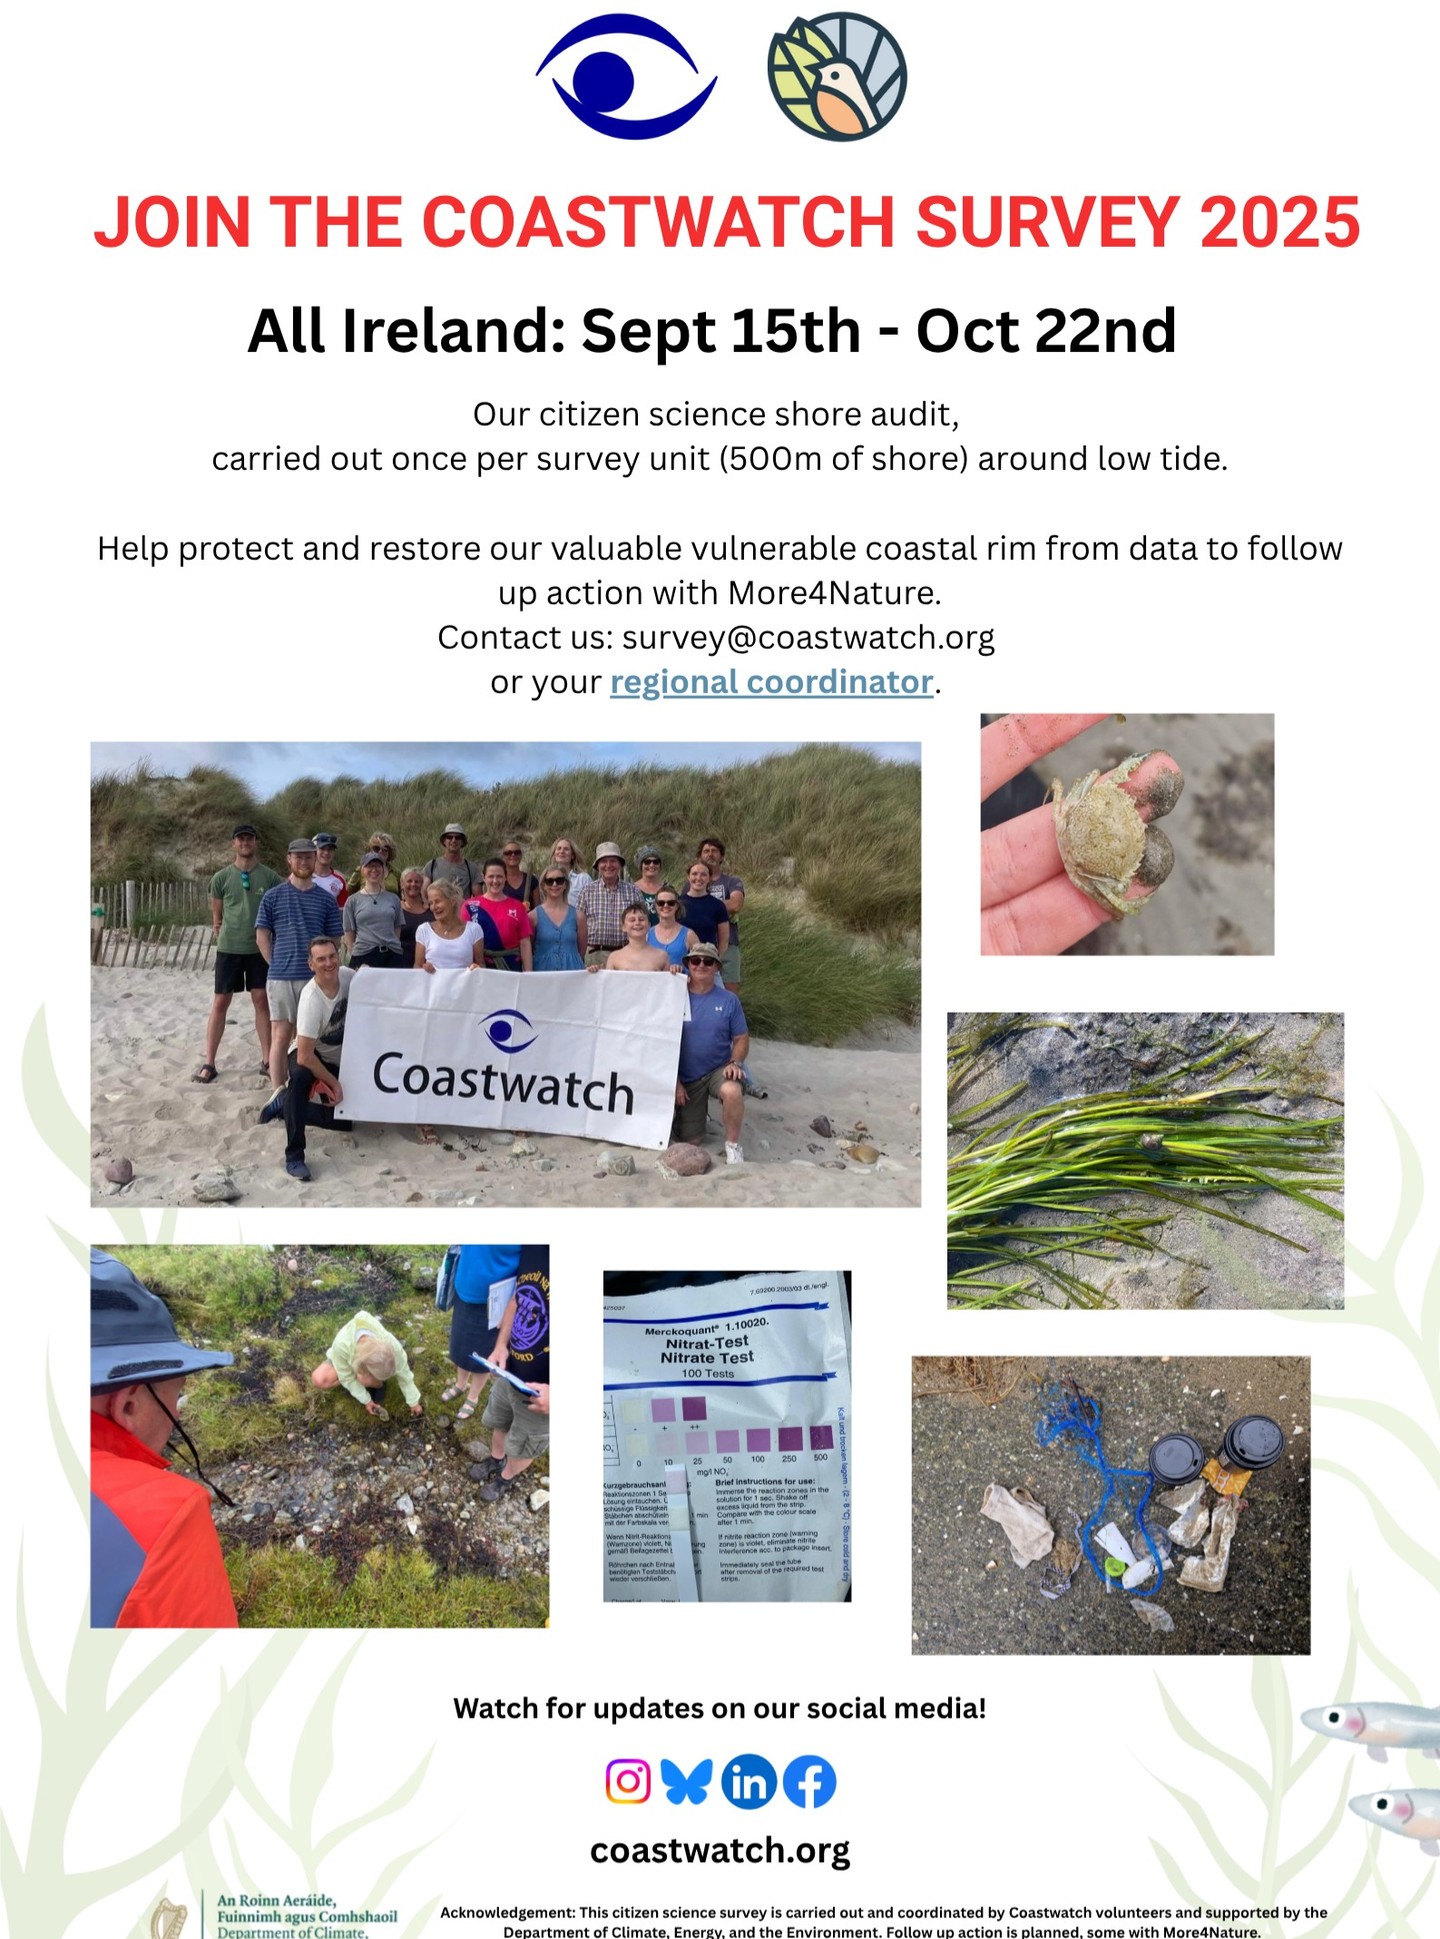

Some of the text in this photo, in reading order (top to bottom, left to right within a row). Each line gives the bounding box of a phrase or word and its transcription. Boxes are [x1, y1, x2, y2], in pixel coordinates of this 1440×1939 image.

[93, 195, 1360, 248] JOIN THE COASTWATCH SURVEY 2025
[247, 305, 1175, 366] All Ireland: Sept 15th - Oct 22nd
[473, 400, 959, 432] Our citizen science shore audit,
[212, 444, 1228, 478] carried out once per survey unit (500m of shore) around low tide.
[99, 534, 1343, 568] Help protect and restore our valuable vulnerable coastal rim from data to follow
[499, 579, 941, 612] up action with More4Nature.
[438, 623, 995, 657] Contact us: survey@coastwatch.org
[491, 667, 942, 702] or your regional coordinator.
[373, 1051, 634, 1116] Coastwatch
[725, 1317, 770, 1332] 1.10020.
[665, 1334, 749, 1350] Nitrat-Test
[660, 1350, 755, 1365] Nitrate Test
[682, 1368, 735, 1379] 100 Tests
[838, 1407, 846, 1421] Kalt
[839, 1422, 847, 1436] und
[840, 1436, 848, 1462] trocken
[636, 1453, 828, 1468] 0 10 25 50 100 250 500
[715, 1478, 734, 1487] Brief
[736, 1478, 783, 1486] instructions
[841, 1572, 850, 1582] dry
[453, 1696, 986, 1725] Watch for updates on our social media!
[732, 1764, 767, 1800] in
[590, 1835, 851, 1871] coastwatch.org
[217, 1894, 337, 1908] An Roinn Aeráide,
[218, 1910, 398, 1926] Fuinnimh agus Comhshaoil
[440, 1906, 1328, 1922] Acknowledgement: This citizen science survey is carried out and coordinated by Coastwatch volunteers and supported by the
[218, 1926, 368, 1939] Department of Climate,
[503, 1926, 1262, 1939] Department of Climate, Energy, and the Environment. Follow up action is planned, some with More4Nature.
